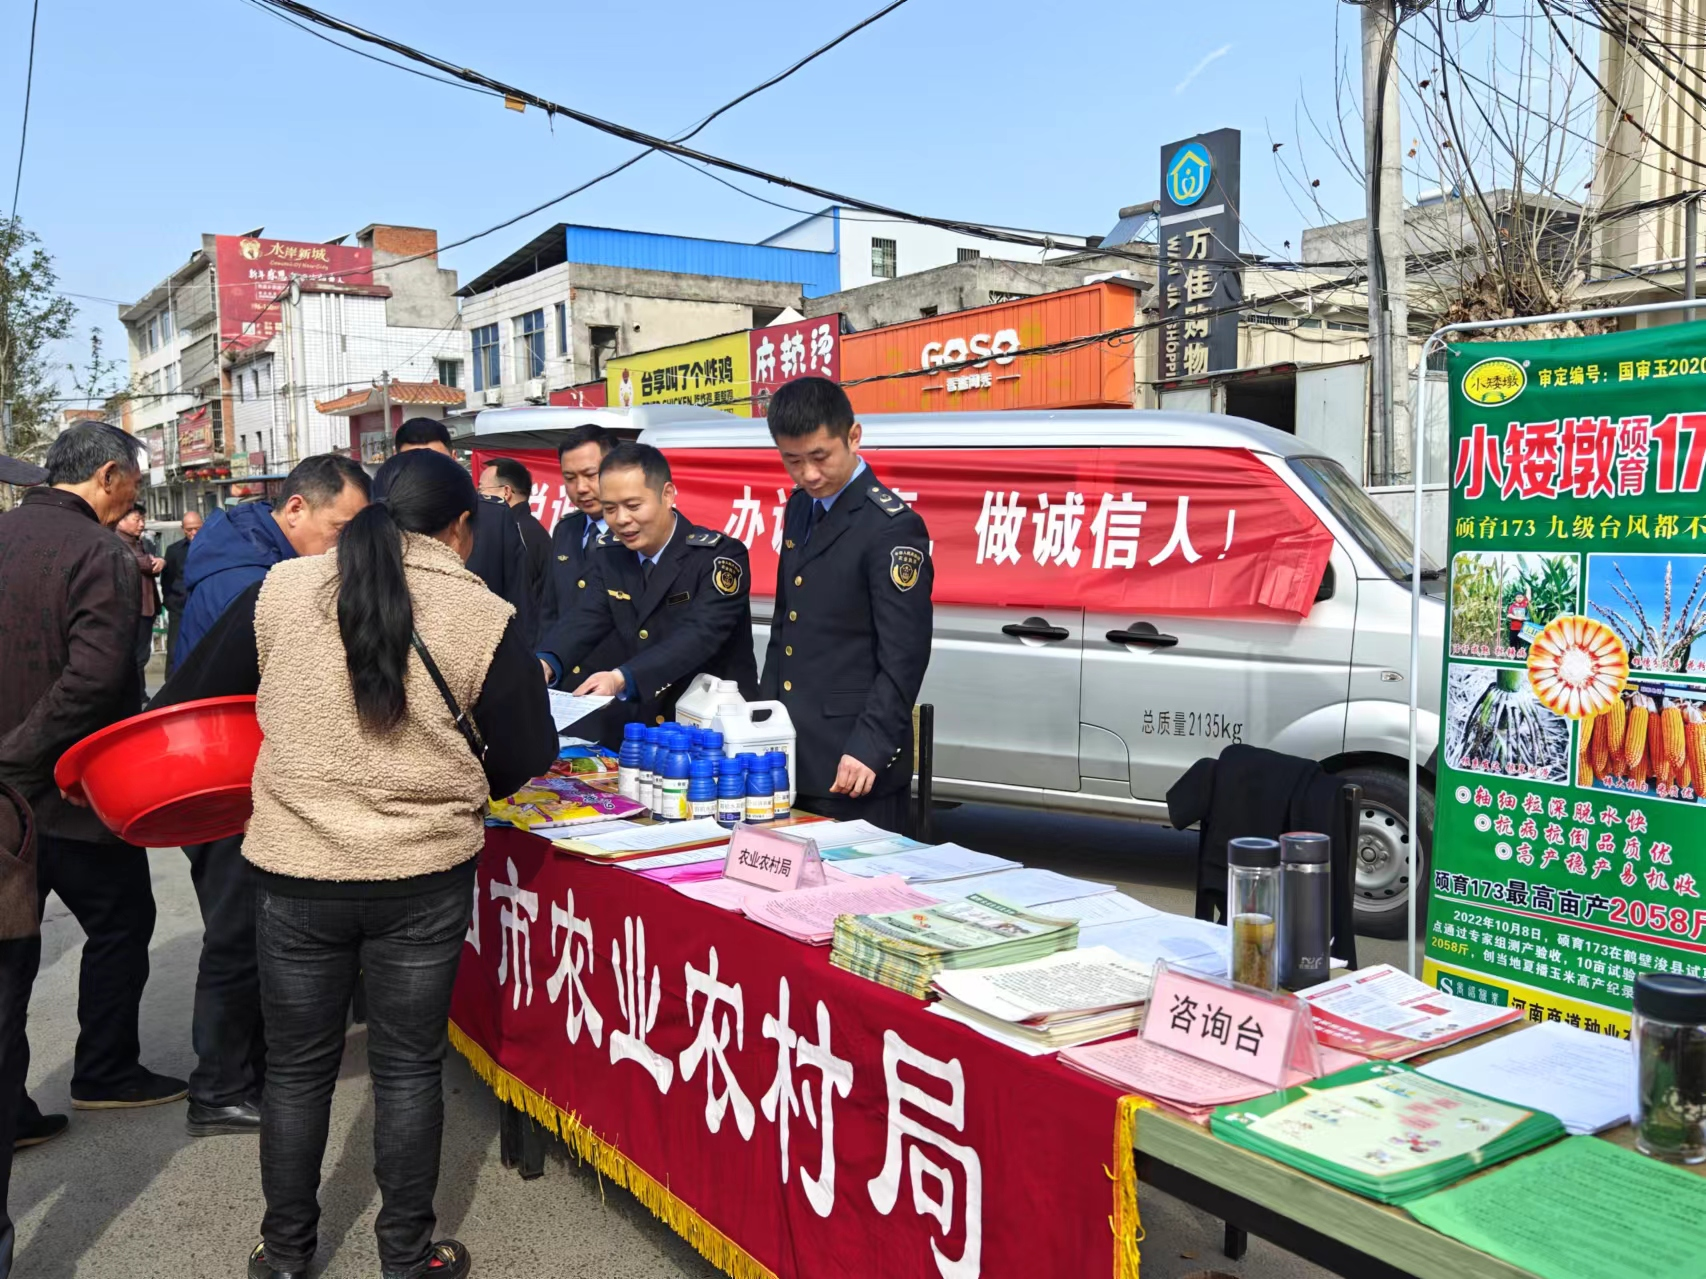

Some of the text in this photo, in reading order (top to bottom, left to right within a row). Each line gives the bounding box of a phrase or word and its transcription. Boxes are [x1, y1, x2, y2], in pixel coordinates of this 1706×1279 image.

[1184, 227, 1213, 375] 万佳购物
[756, 323, 835, 382] 麻辣烫
[921, 328, 1021, 375] GOSO
[641, 356, 733, 397] 台享叫了个炸鸡
[1455, 513, 1706, 540] 硕育173 九级台风都不
[1142, 709, 1243, 745] 总质量2135kg
[1473, 786, 1649, 834] 轴细粒深脱水快
[738, 848, 791, 877] 农业农村局
[1493, 815, 1673, 866] 抗病抗倒品质优
[1516, 842, 1700, 898] 高产稳产易机收
[1169, 993, 1266, 1057] 咨询台
[465, 856, 982, 1279] 市农业农村局
